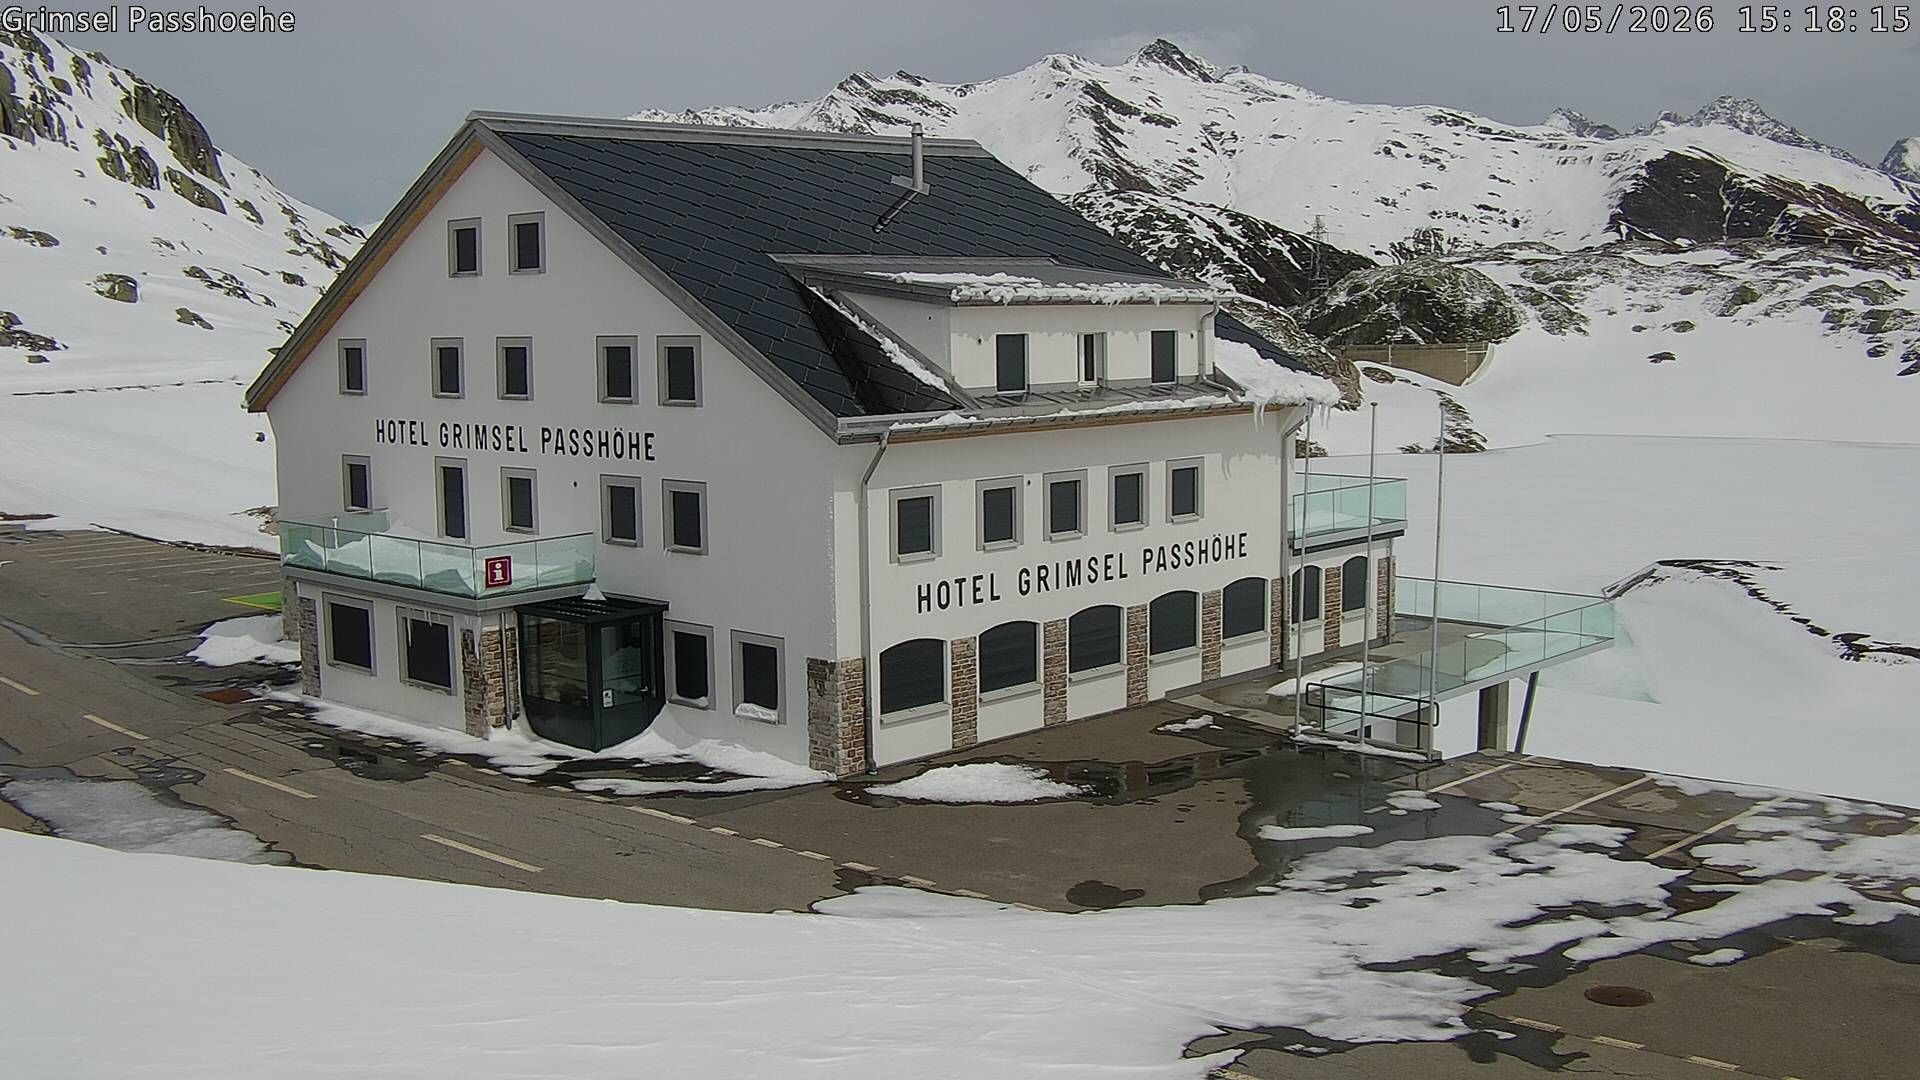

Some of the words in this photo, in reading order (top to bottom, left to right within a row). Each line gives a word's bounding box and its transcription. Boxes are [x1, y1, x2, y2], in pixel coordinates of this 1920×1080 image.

[375, 419, 428, 446] HOTEL
[439, 422, 528, 452] GRIMSEL
[541, 427, 655, 461] PASSHÖHE
[917, 573, 1001, 614] HOTEL
[1018, 552, 1128, 597] GRIMSEL
[1142, 532, 1248, 575] PASSHÖHE
